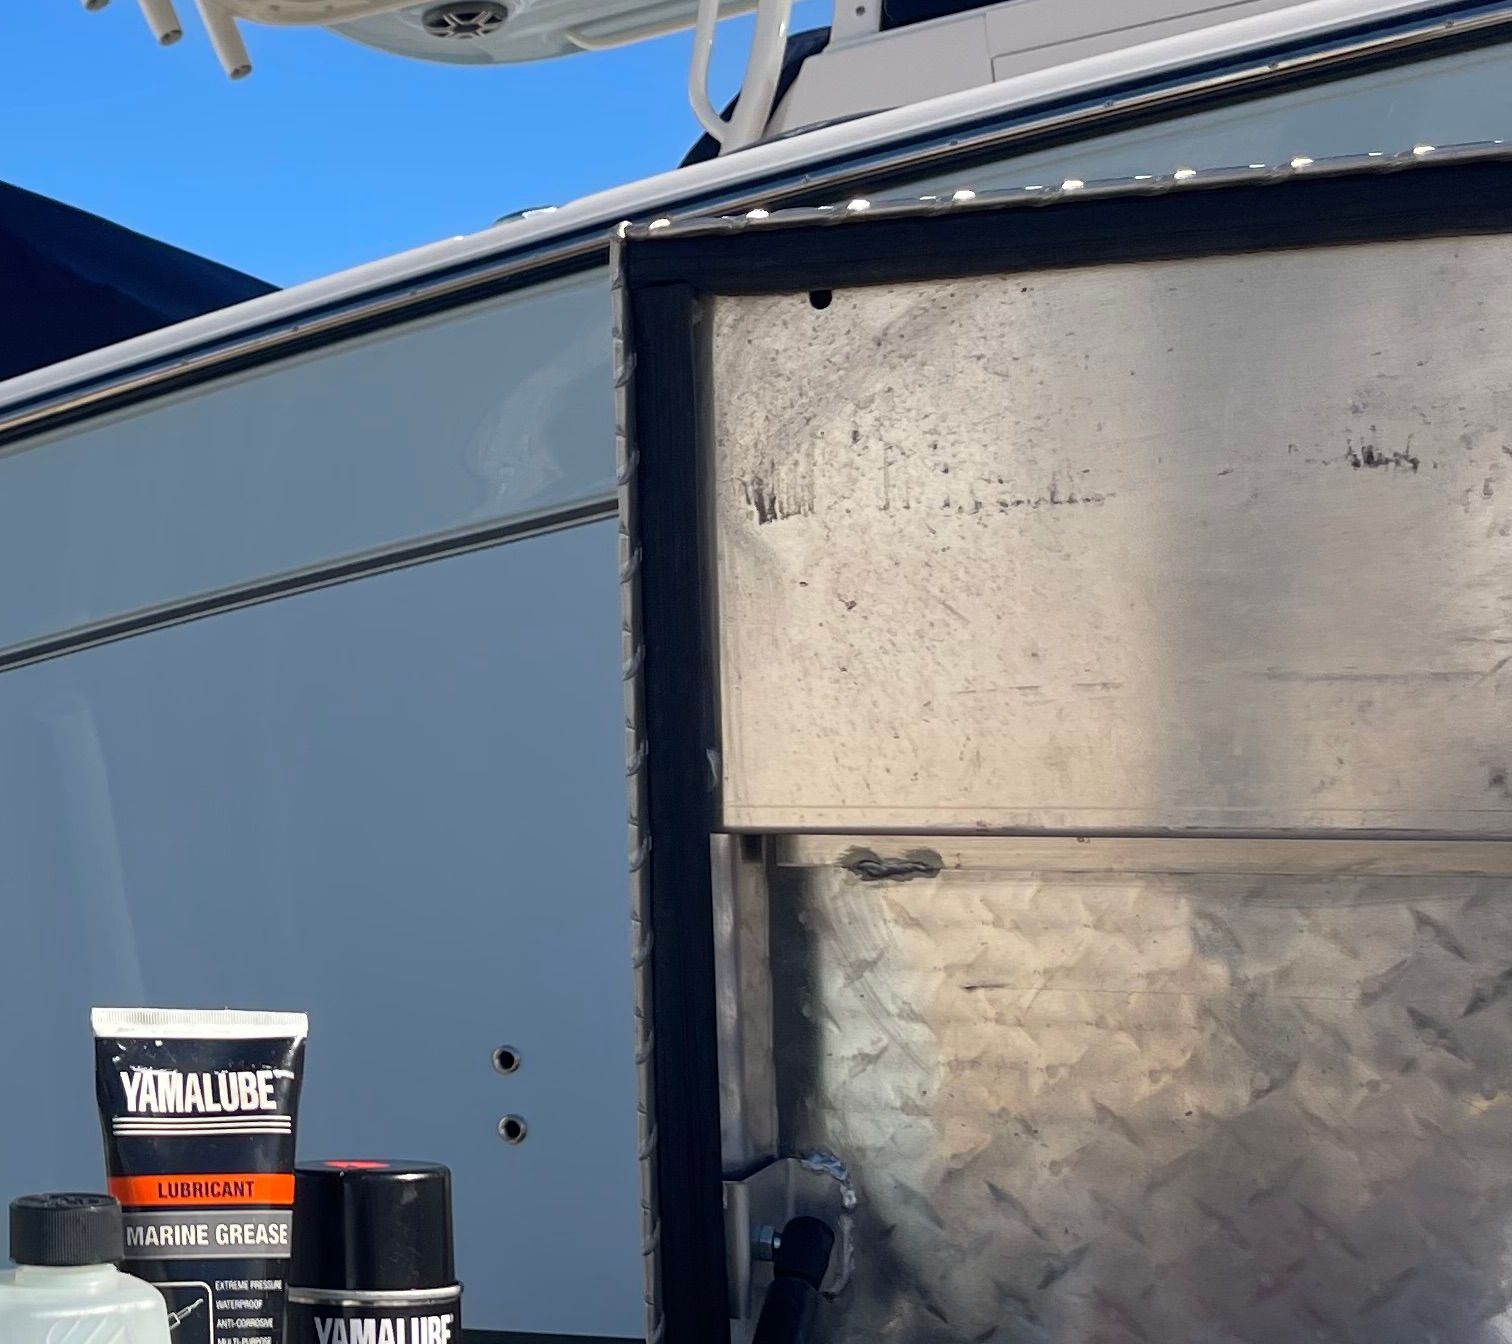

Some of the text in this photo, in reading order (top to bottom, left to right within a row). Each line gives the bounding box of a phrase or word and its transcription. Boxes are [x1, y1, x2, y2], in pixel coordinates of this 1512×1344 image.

[119, 1070, 277, 1113] YAMALUBE
[157, 1180, 255, 1199] LUBRICANT
[126, 1223, 288, 1247] MARINE GREASE
